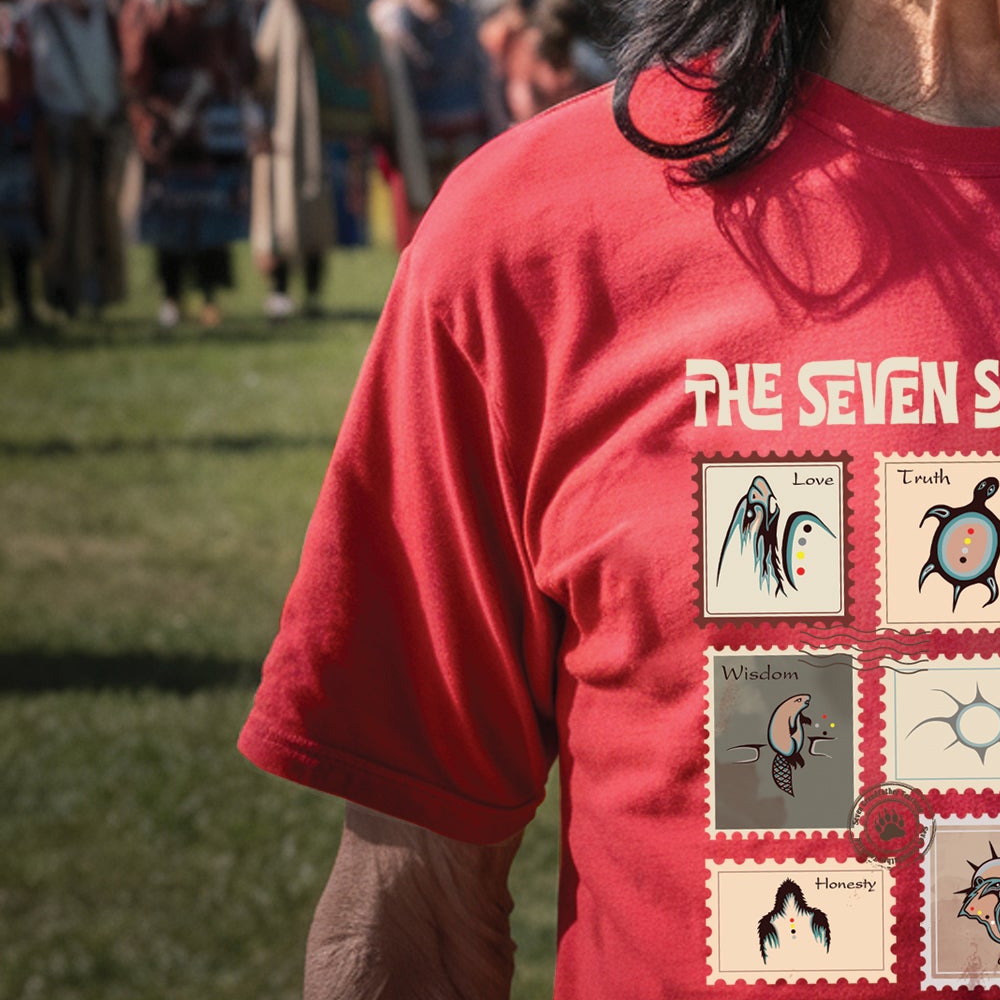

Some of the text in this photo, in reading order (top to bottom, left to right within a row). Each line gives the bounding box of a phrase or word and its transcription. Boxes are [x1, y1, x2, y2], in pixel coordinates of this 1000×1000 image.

[685, 358, 783, 431] THE
[797, 356, 959, 428] SEVEN
[792, 472, 835, 487] Love
[897, 468, 951, 486] Truth
[721, 664, 799, 682] Wisdom
[815, 877, 877, 893] Honesty
